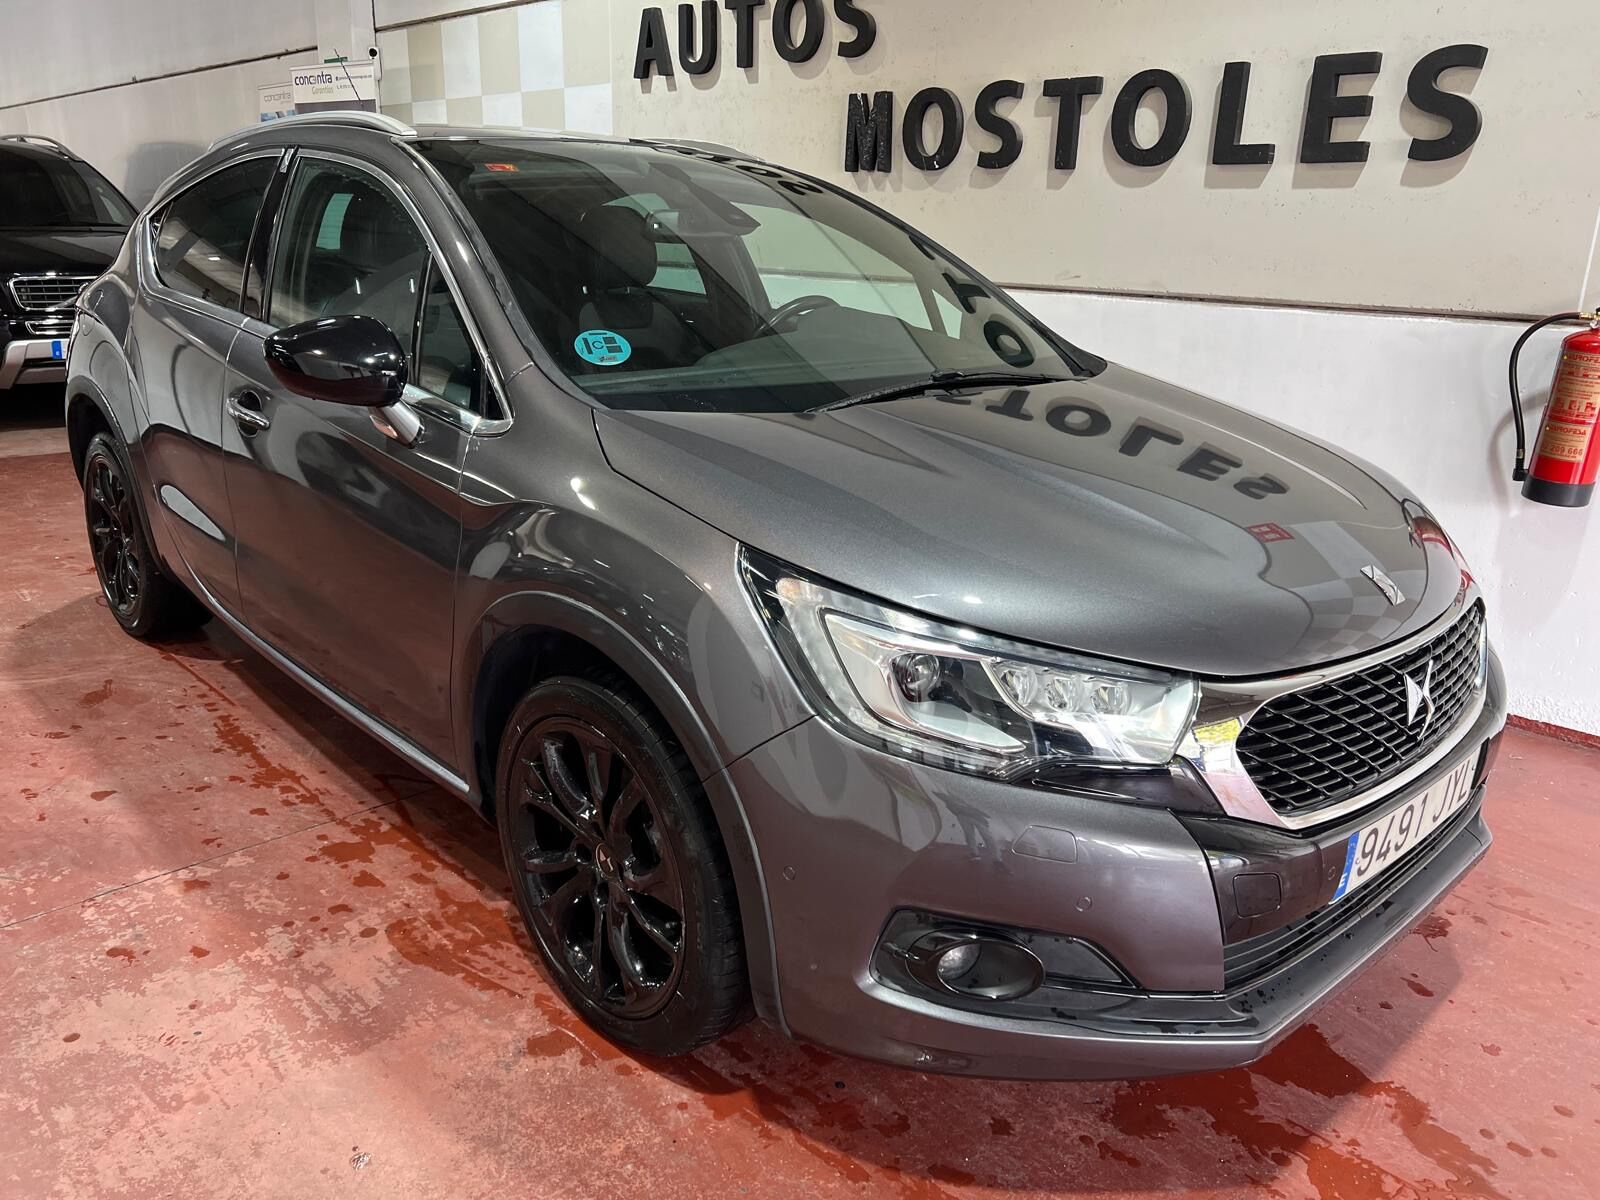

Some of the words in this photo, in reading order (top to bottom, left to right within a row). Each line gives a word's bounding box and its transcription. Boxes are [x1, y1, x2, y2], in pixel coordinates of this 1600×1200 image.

[633, 0, 877, 79] AUTOS
[844, 44, 1489, 173] MOSTOLES
[1356, 792, 1429, 877] 9491
[1432, 758, 1471, 823] JYL
